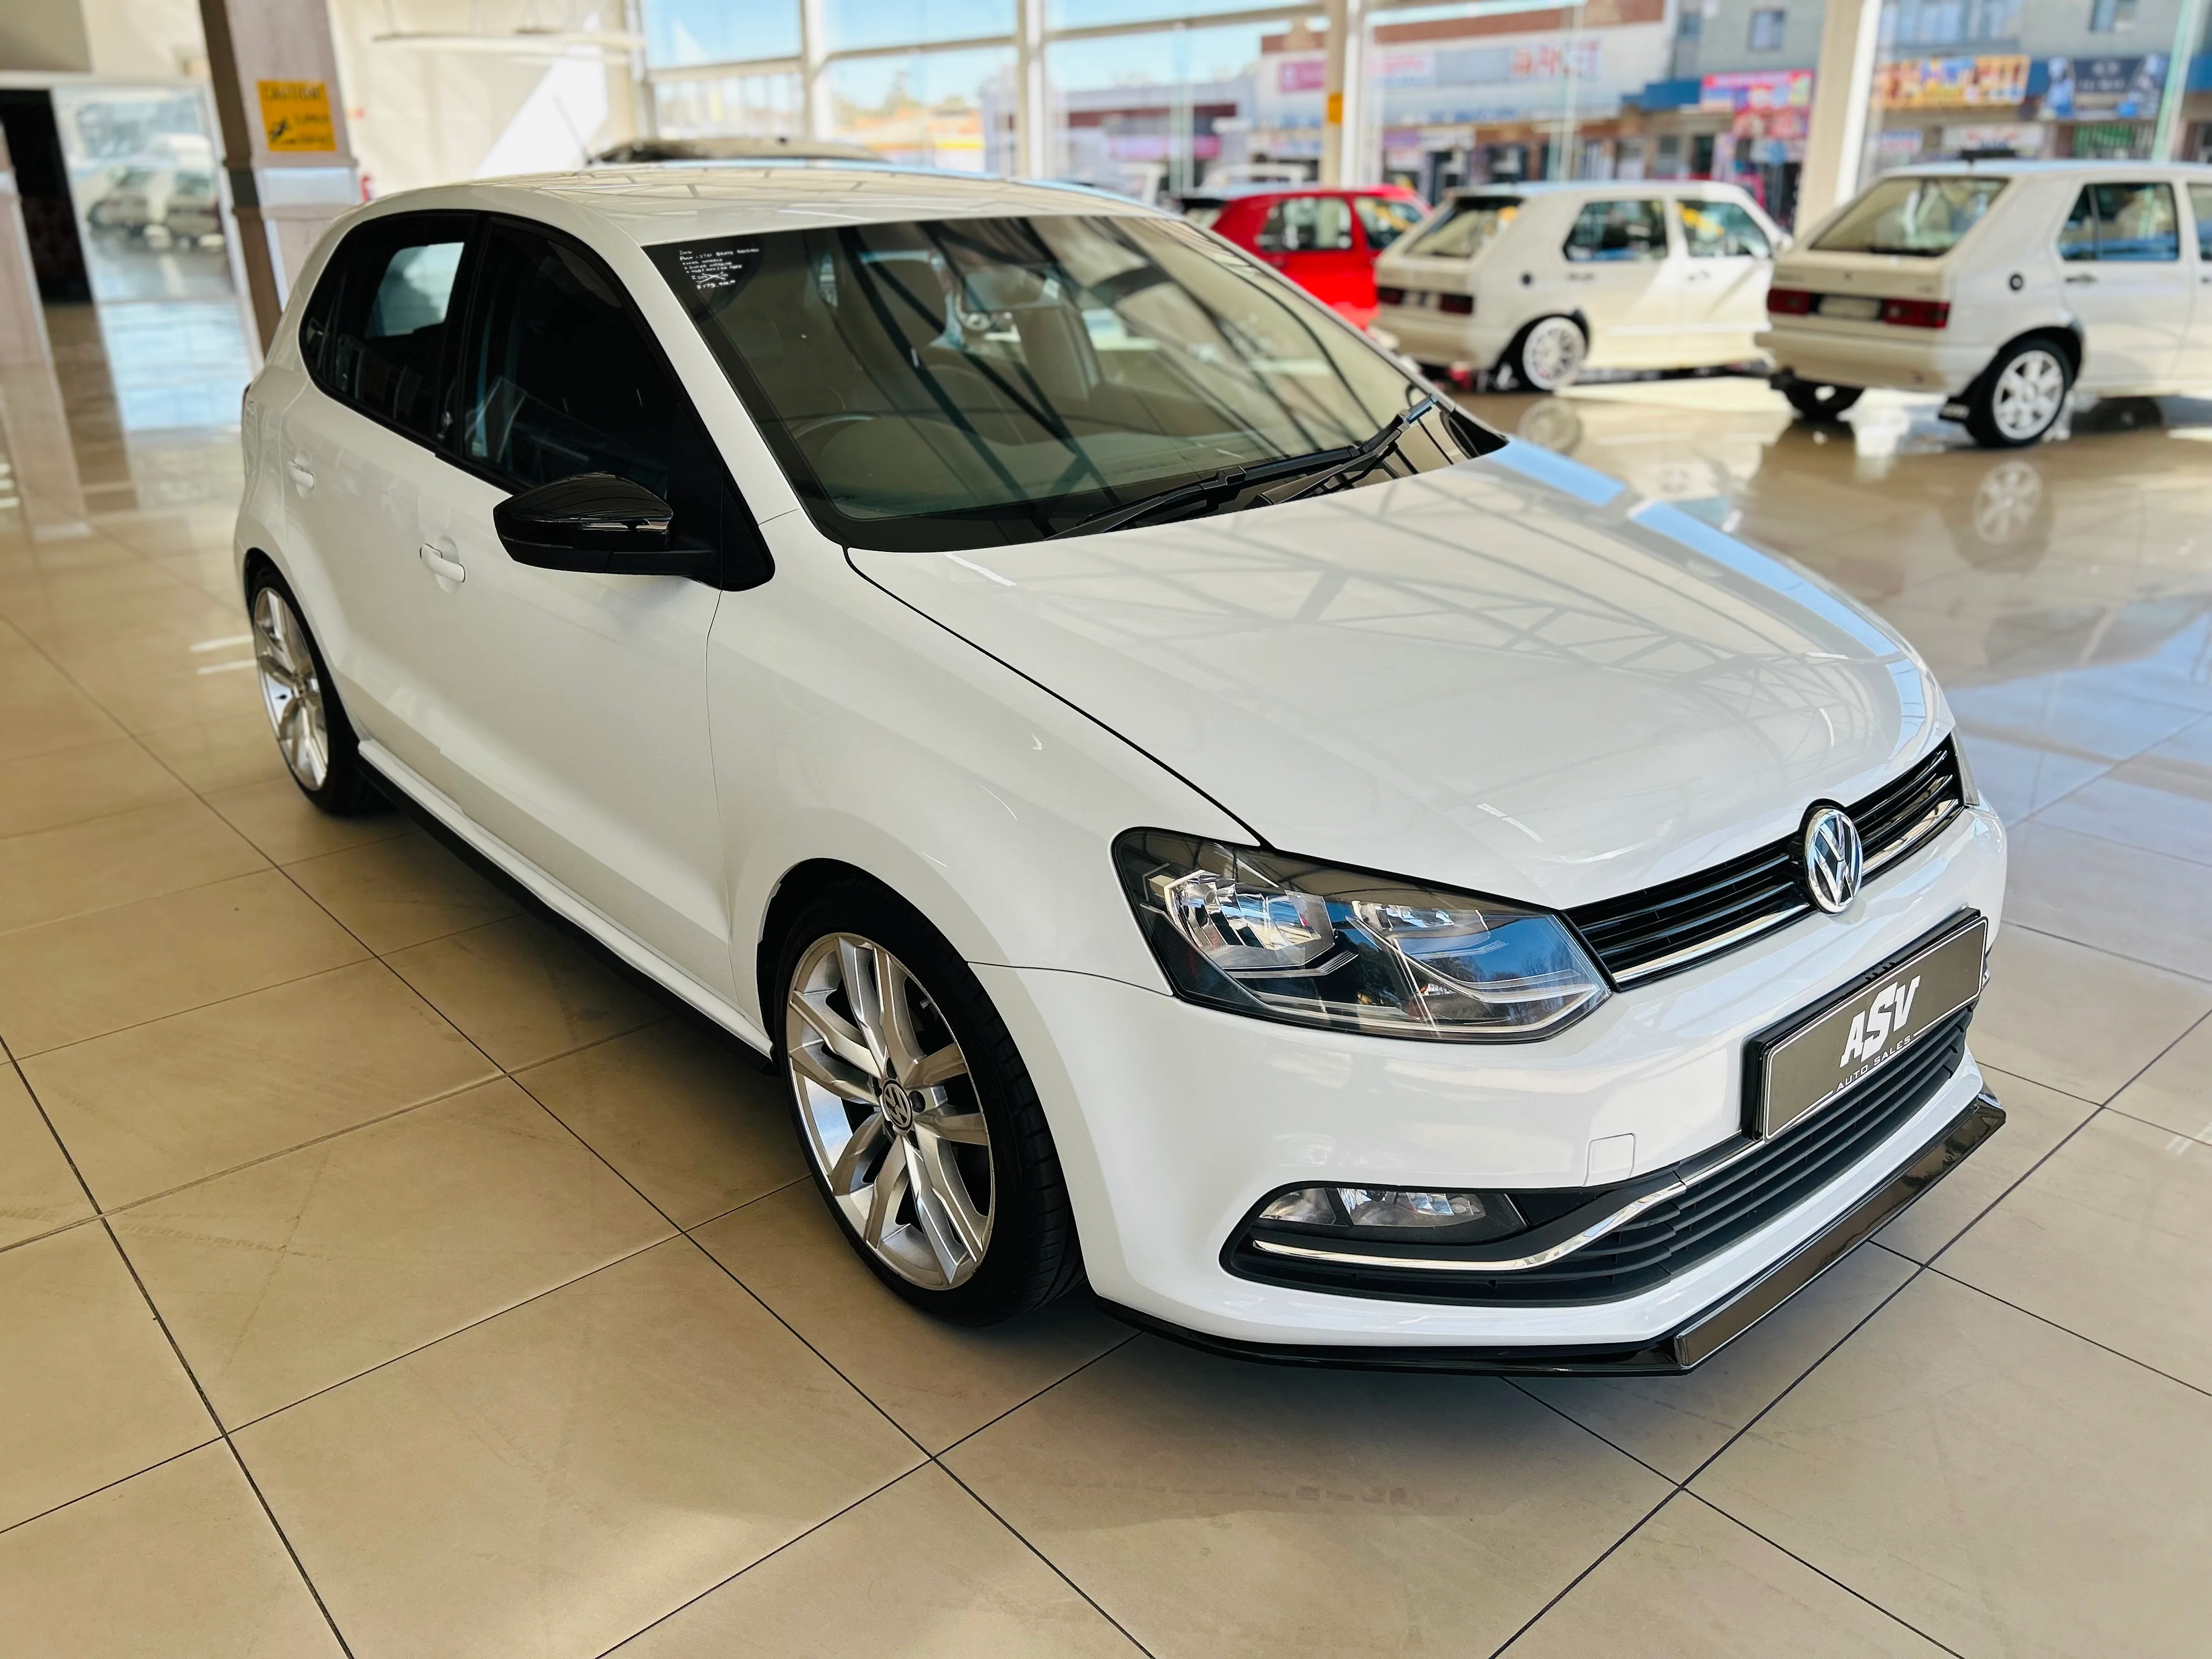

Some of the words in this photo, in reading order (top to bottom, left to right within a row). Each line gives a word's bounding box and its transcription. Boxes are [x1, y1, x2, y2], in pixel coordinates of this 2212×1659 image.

[1839, 975, 1920, 1068] ASV
[1836, 1064, 1869, 1092] AUTO
[1873, 1035, 1911, 1065] SALES
